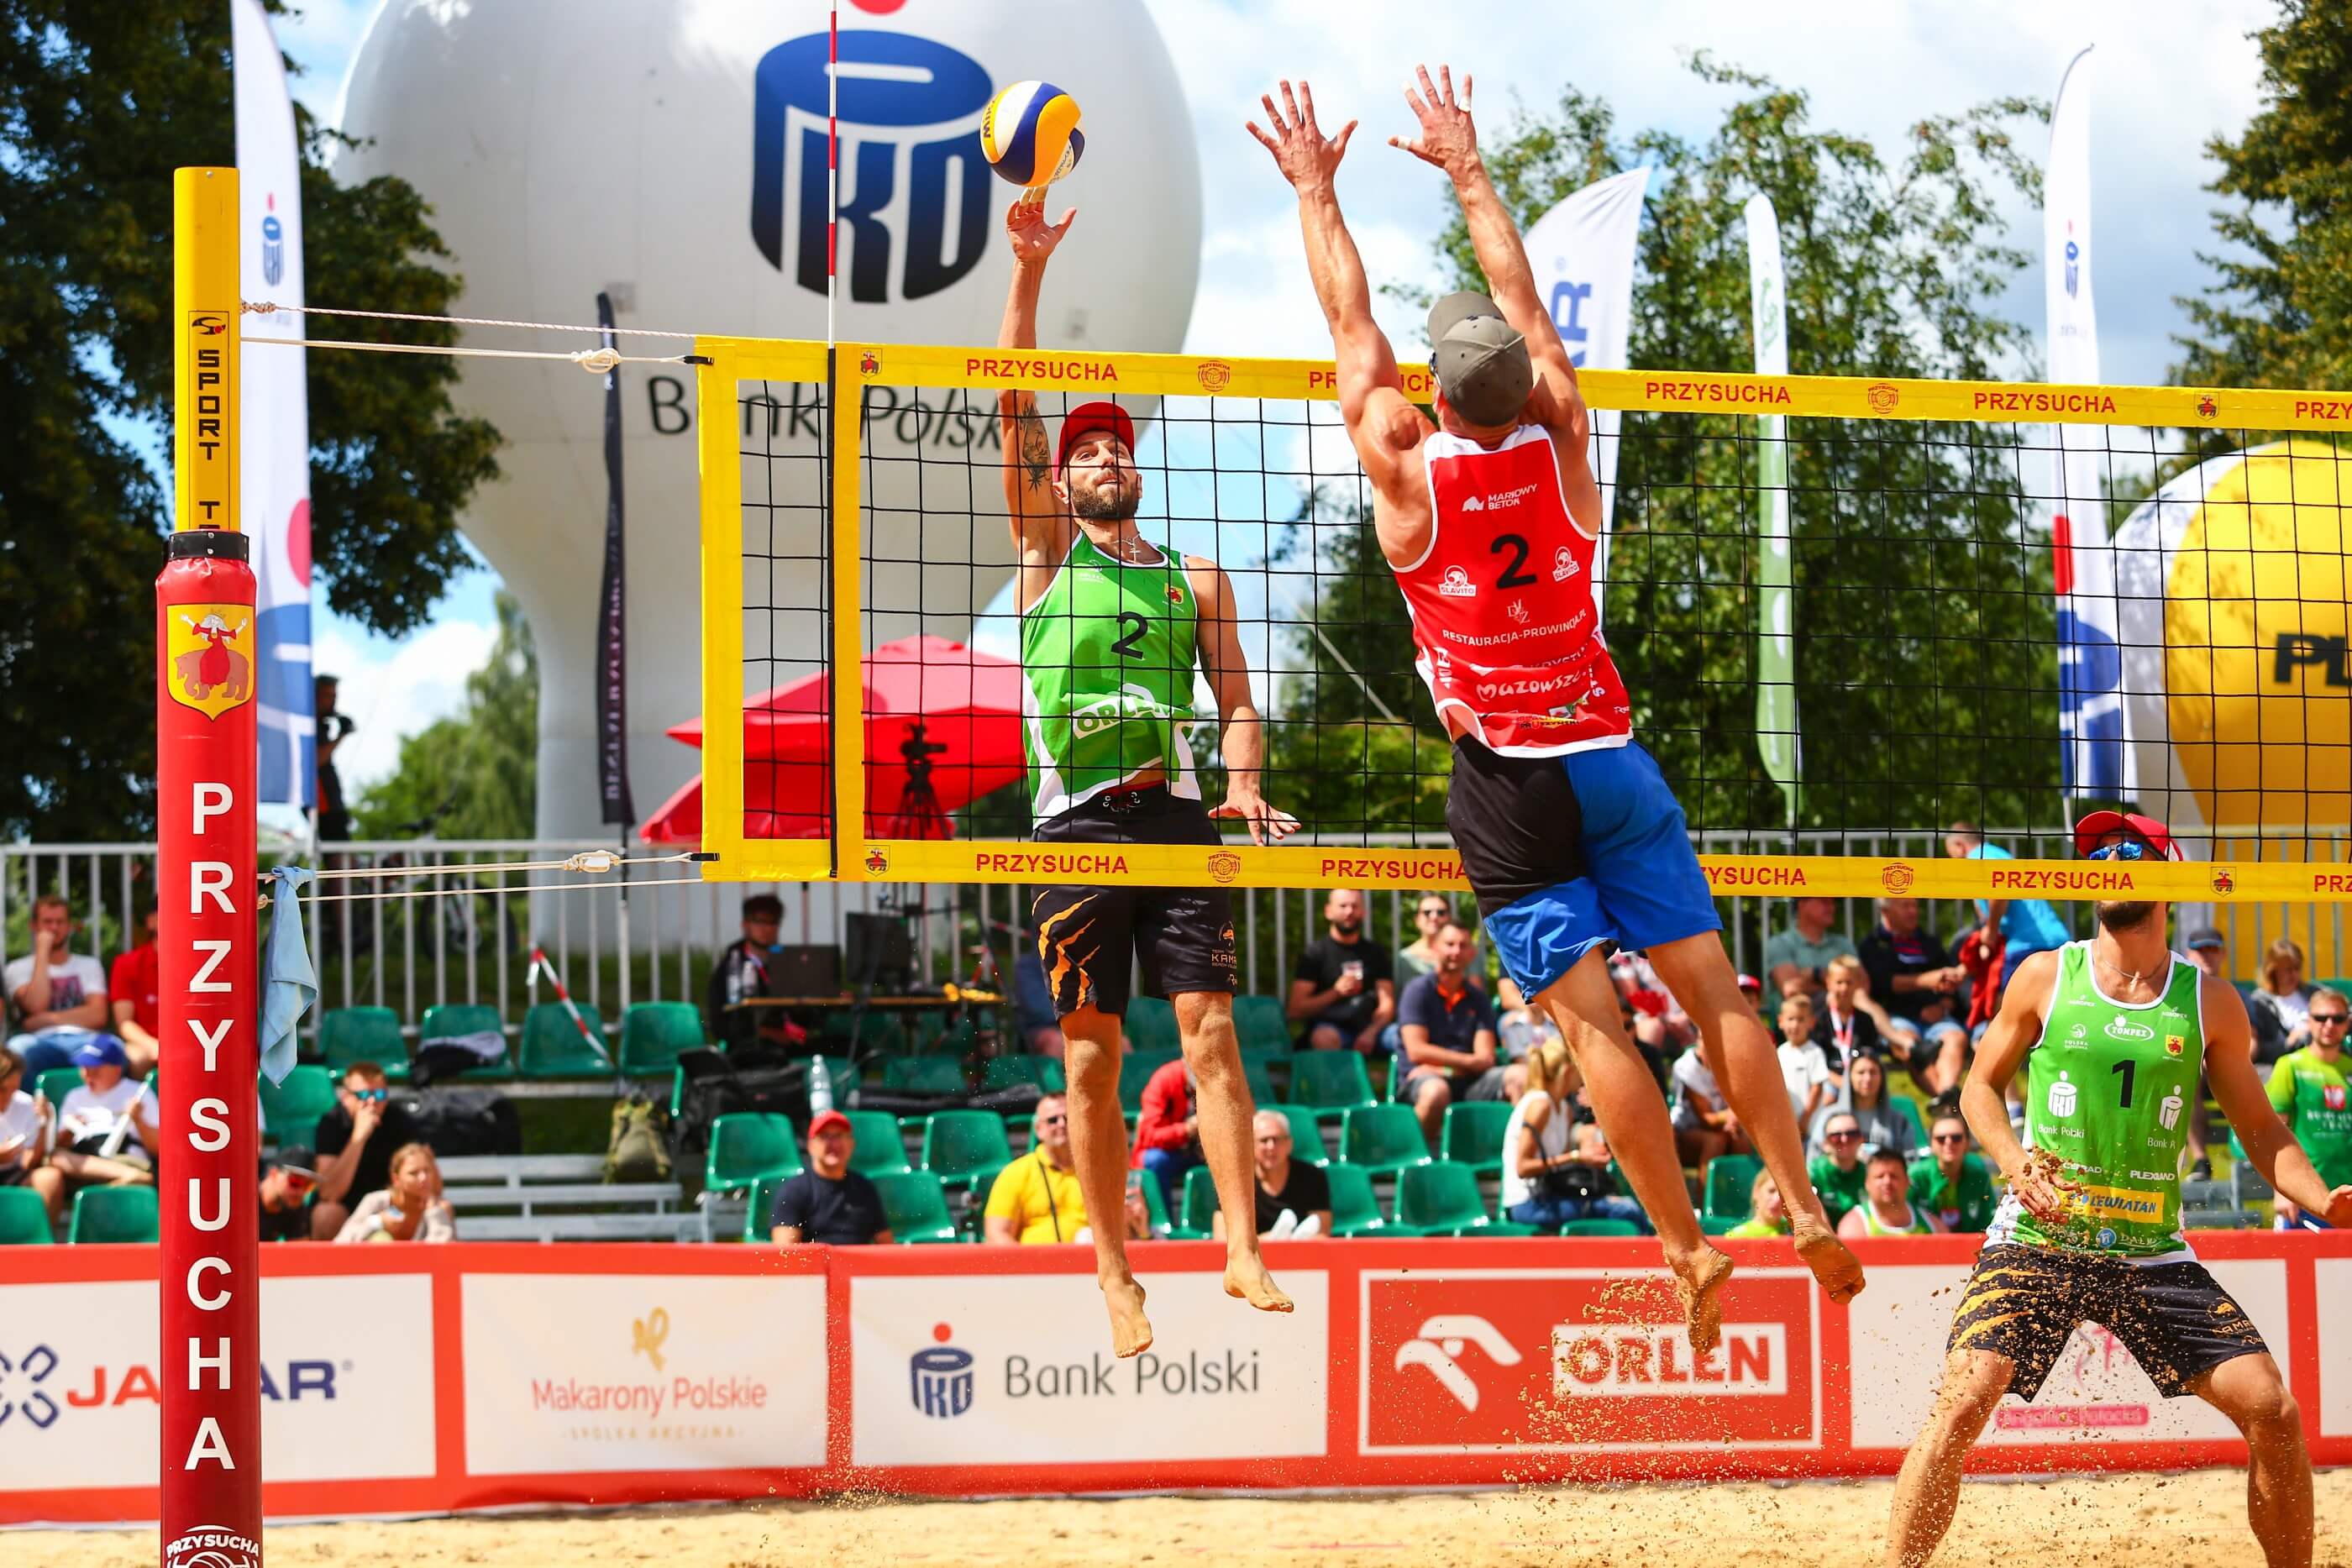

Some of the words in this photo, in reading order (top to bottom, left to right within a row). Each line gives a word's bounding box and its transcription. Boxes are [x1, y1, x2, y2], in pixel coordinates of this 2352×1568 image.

[967, 359, 1118, 382] PRZYSUCHA
[1646, 381, 1792, 403] PRZYSUCHA
[1975, 391, 2116, 413] PRZYSUCHA
[198, 349, 220, 460] SPORT
[647, 375, 827, 438] Bnk
[859, 385, 1001, 451] Polsk
[2296, 401, 2352, 420] PRZY
[199, 501, 220, 529] T
[1491, 533, 1538, 590] 2
[1554, 564, 1578, 581] SLAVITO
[1441, 585, 1476, 595] SLAVITO
[1110, 611, 1149, 661] 2
[976, 853, 1128, 874] PRZYSUCHA
[1991, 870, 2134, 890] PRZYSUCHA
[2111, 1025, 2148, 1038] TOMPEX
[2111, 1059, 2137, 1109] 1
[185, 782, 237, 1471] PRZYSUCHA
[2038, 1123, 2058, 1135] Bank
[2147, 1136, 2166, 1148] Bank
[2090, 1195, 2157, 1213] LEWIATAN
[1569, 1334, 1770, 1384] ORLEN
[1005, 1354, 1116, 1398] Bank
[1136, 1350, 1259, 1395] Polski
[532, 1377, 666, 1419] Makarony
[673, 1376, 768, 1409] Polskie
[165, 1534, 259, 1559] PRZYSUCHA
